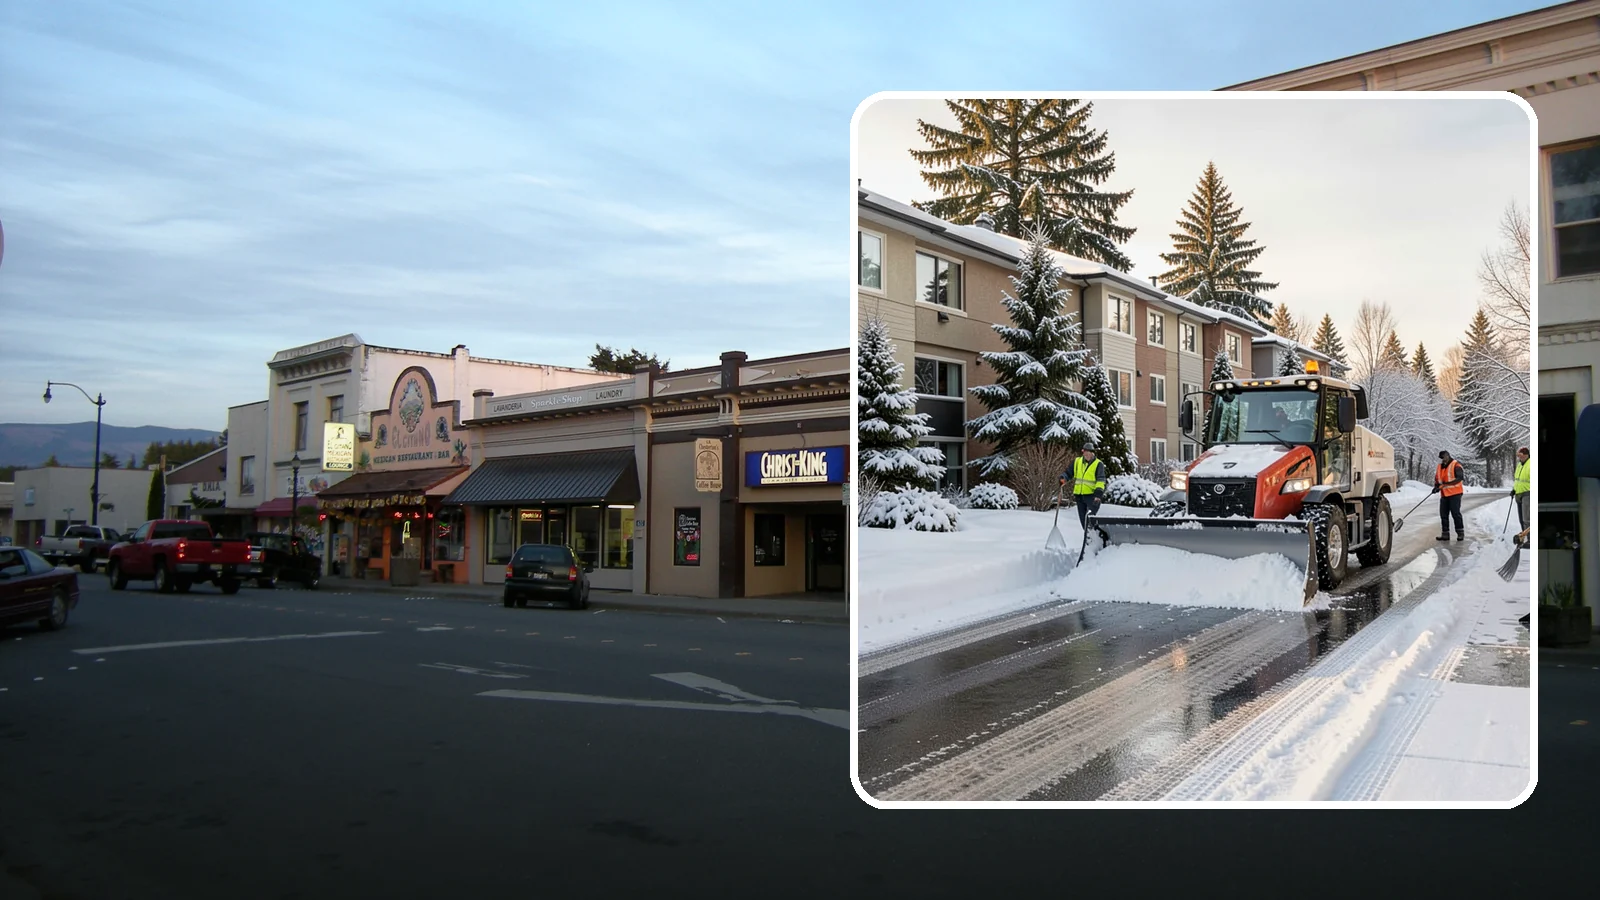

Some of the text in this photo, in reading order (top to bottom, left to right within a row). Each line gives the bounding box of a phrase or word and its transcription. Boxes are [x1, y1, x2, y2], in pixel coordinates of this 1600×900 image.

[562, 394, 583, 404] Shop
[595, 389, 623, 400] LAUNDRY
[493, 402, 522, 413] LAVANDERIA
[373, 450, 450, 464] MEXICAN RESTAURANT BAR
[760, 450, 827, 478] CHRIST KING
[696, 480, 722, 489] Coffee House
